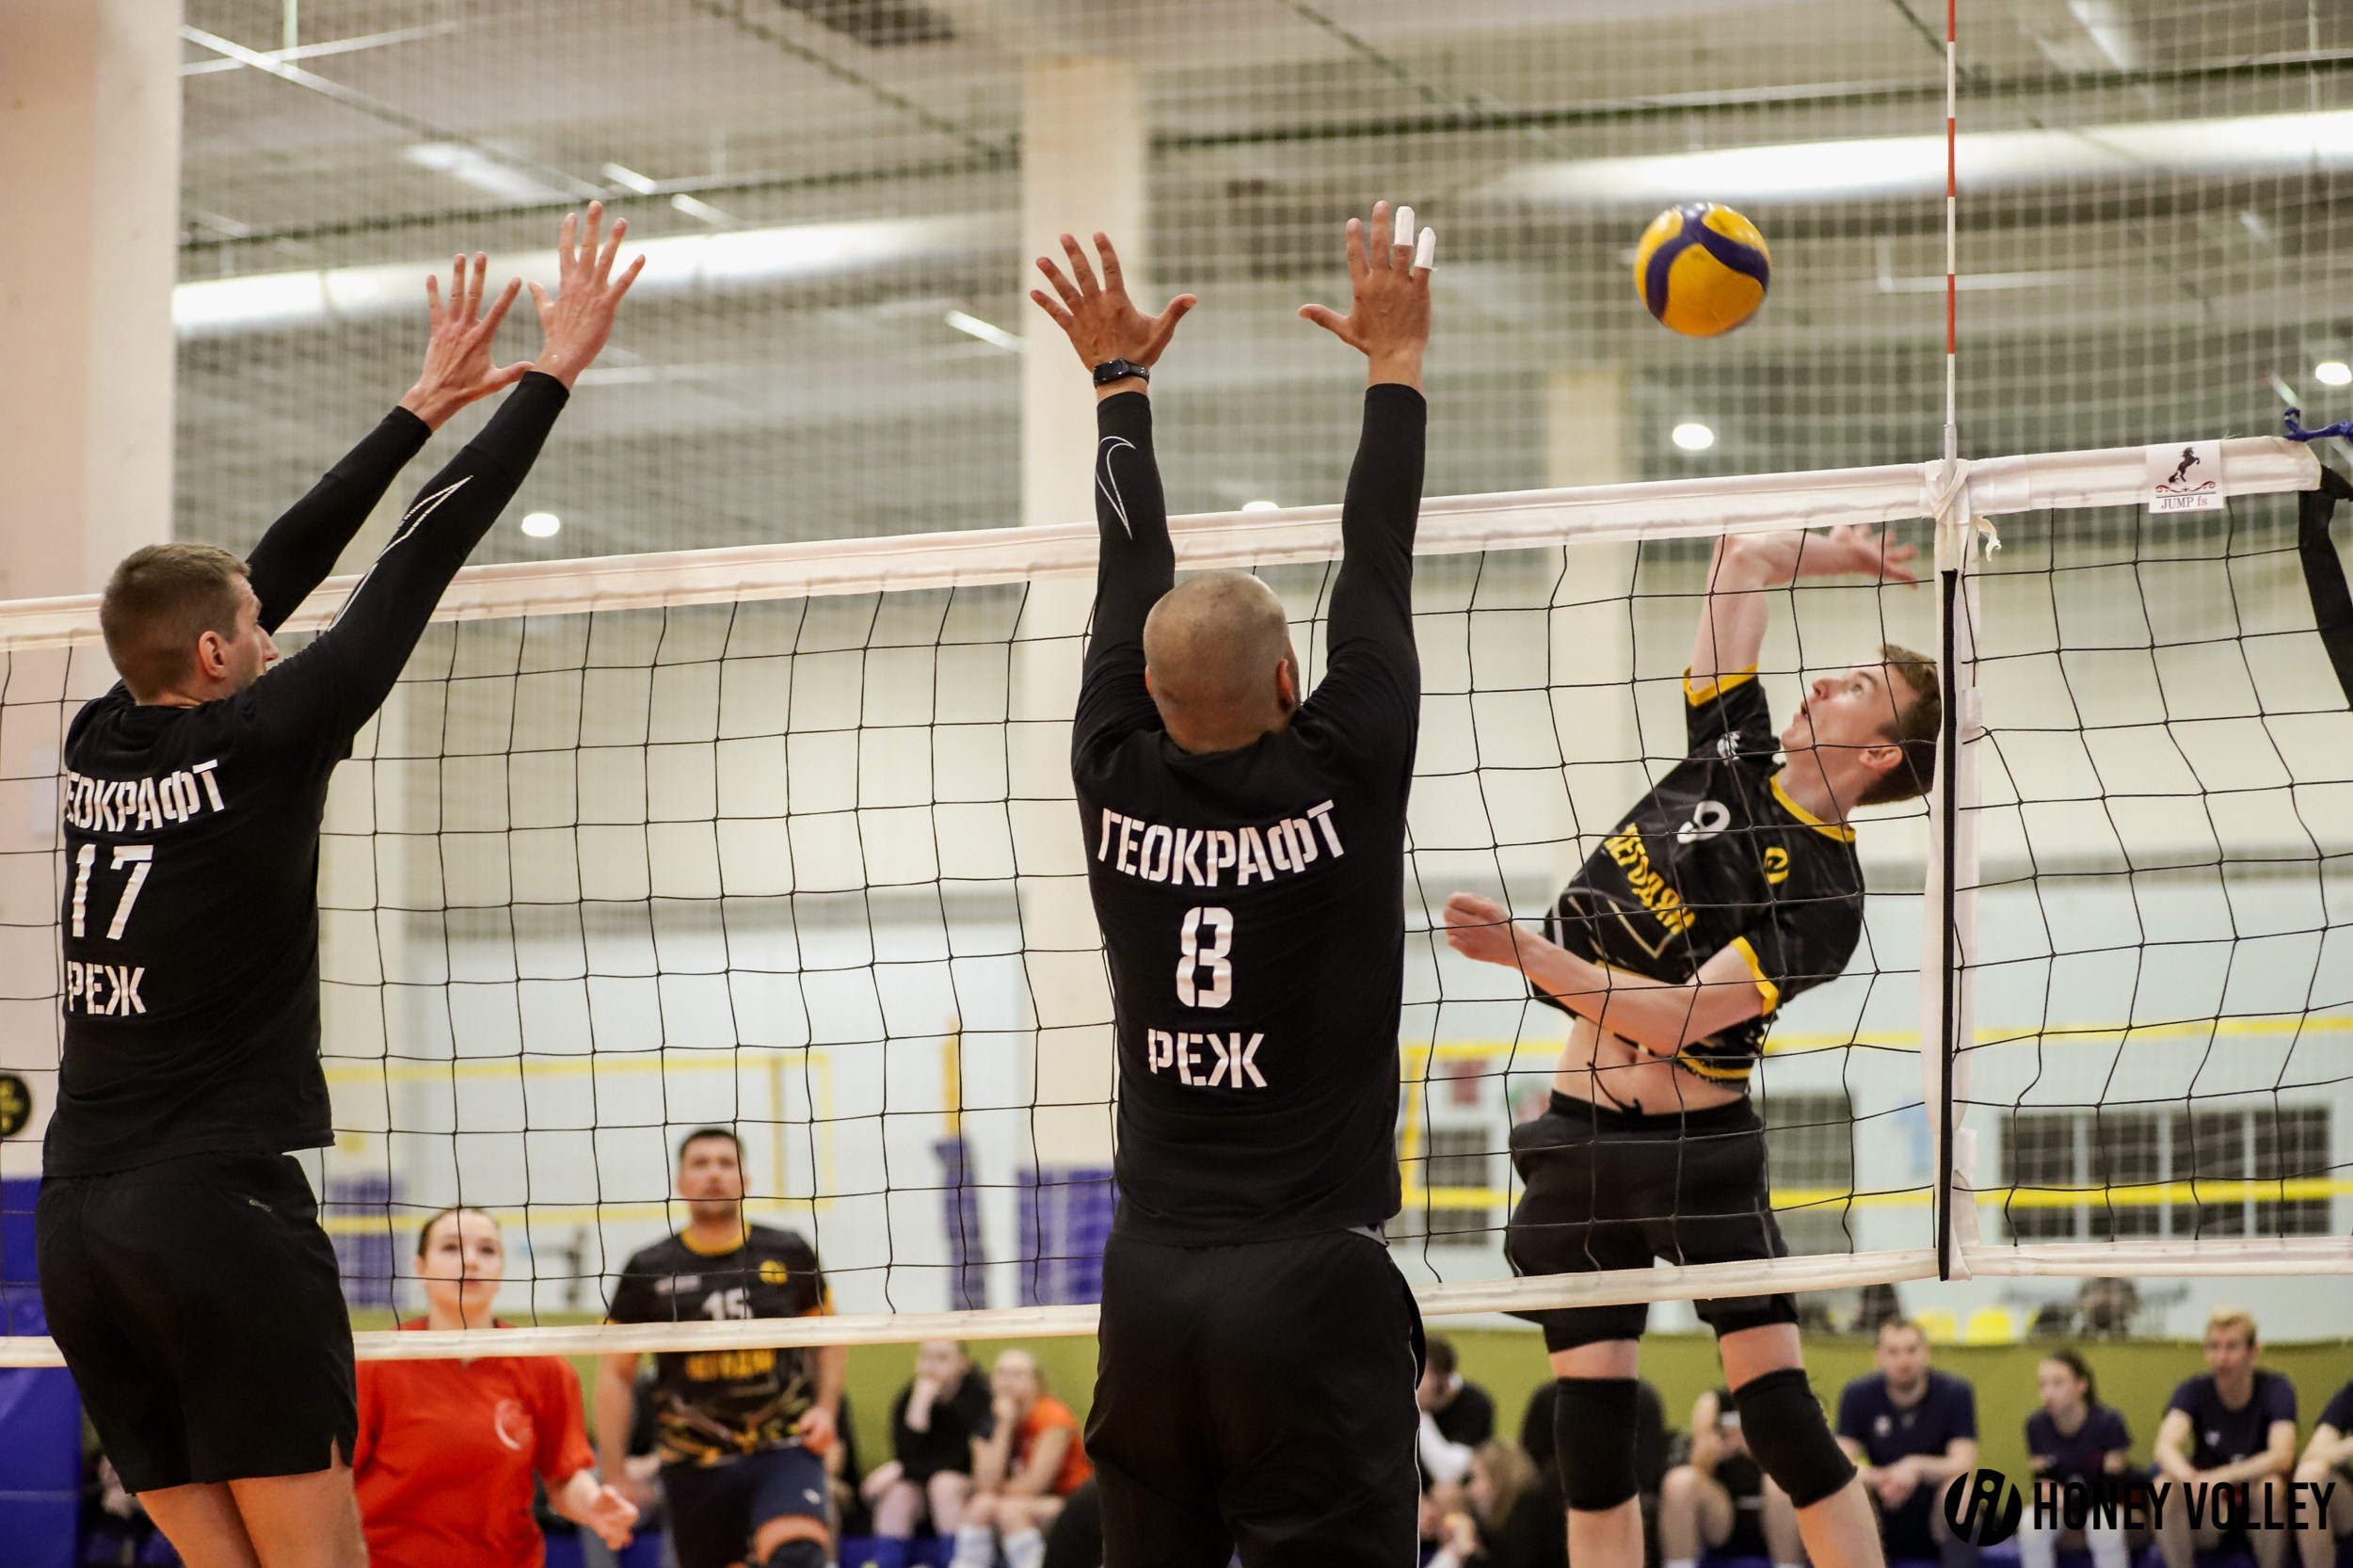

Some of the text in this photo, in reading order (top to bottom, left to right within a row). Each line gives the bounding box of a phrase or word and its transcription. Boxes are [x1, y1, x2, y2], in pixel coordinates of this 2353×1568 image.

[2161, 496, 2208, 509] JUMP fs
[66, 759, 225, 832] ЕОКРАФТ
[1097, 799, 1344, 887] ГЕОКРАФТ
[72, 843, 154, 940] 17
[67, 960, 147, 1016] РЕЖ
[1176, 906, 1234, 1008] 8
[1147, 1028, 1268, 1089] РЕЖ
